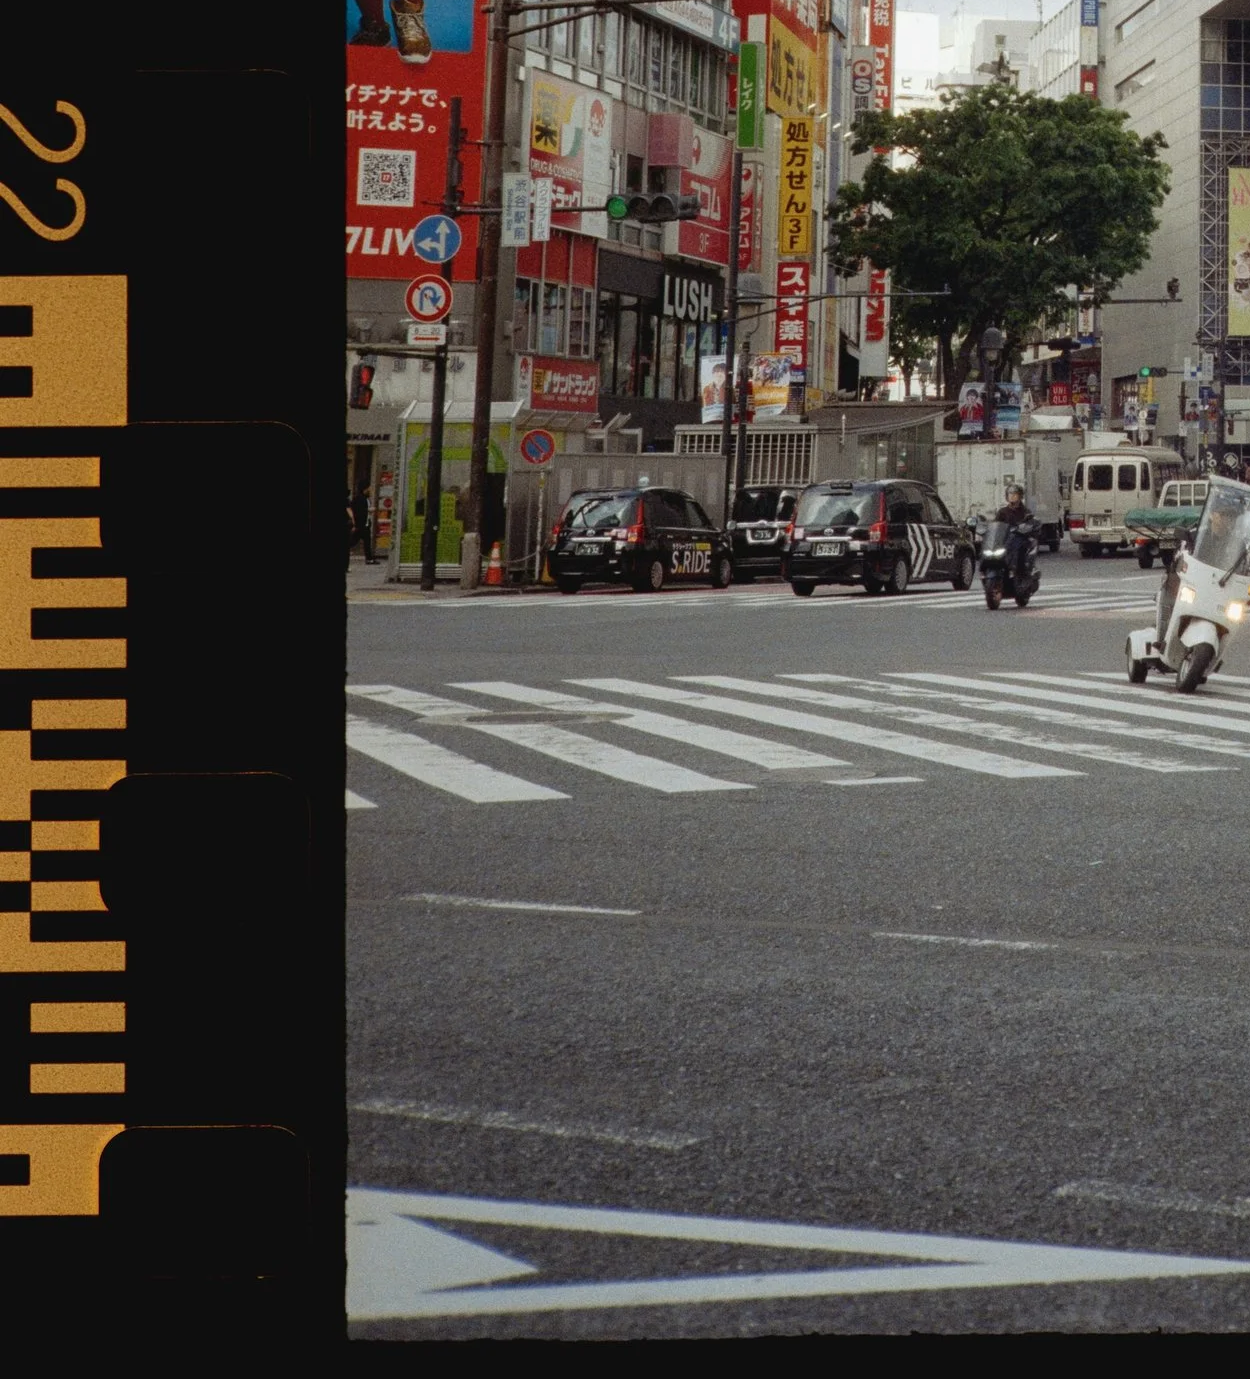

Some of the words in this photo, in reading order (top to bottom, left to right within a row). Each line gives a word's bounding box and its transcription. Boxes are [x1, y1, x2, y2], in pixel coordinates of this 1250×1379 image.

[718, 16, 738, 49] 4F
[345, 84, 448, 108] イチナナで、
[741, 78, 753, 111] レイク
[346, 109, 437, 133] 叶えよう。
[785, 122, 809, 214] 処方せん
[514, 178, 528, 241] 渋谷駅前
[345, 226, 417, 257] 7LIV
[739, 207, 751, 248] アコム
[788, 220, 802, 250] 3F
[663, 274, 714, 321] LUSH
[779, 267, 805, 366] スギ薬局
[552, 372, 597, 396] サンドラッグ
[1052, 386, 1067, 395] UNI
[1052, 395, 1068, 404] QLO
[671, 550, 712, 575] S.RIDE
[935, 539, 956, 561] Uber
